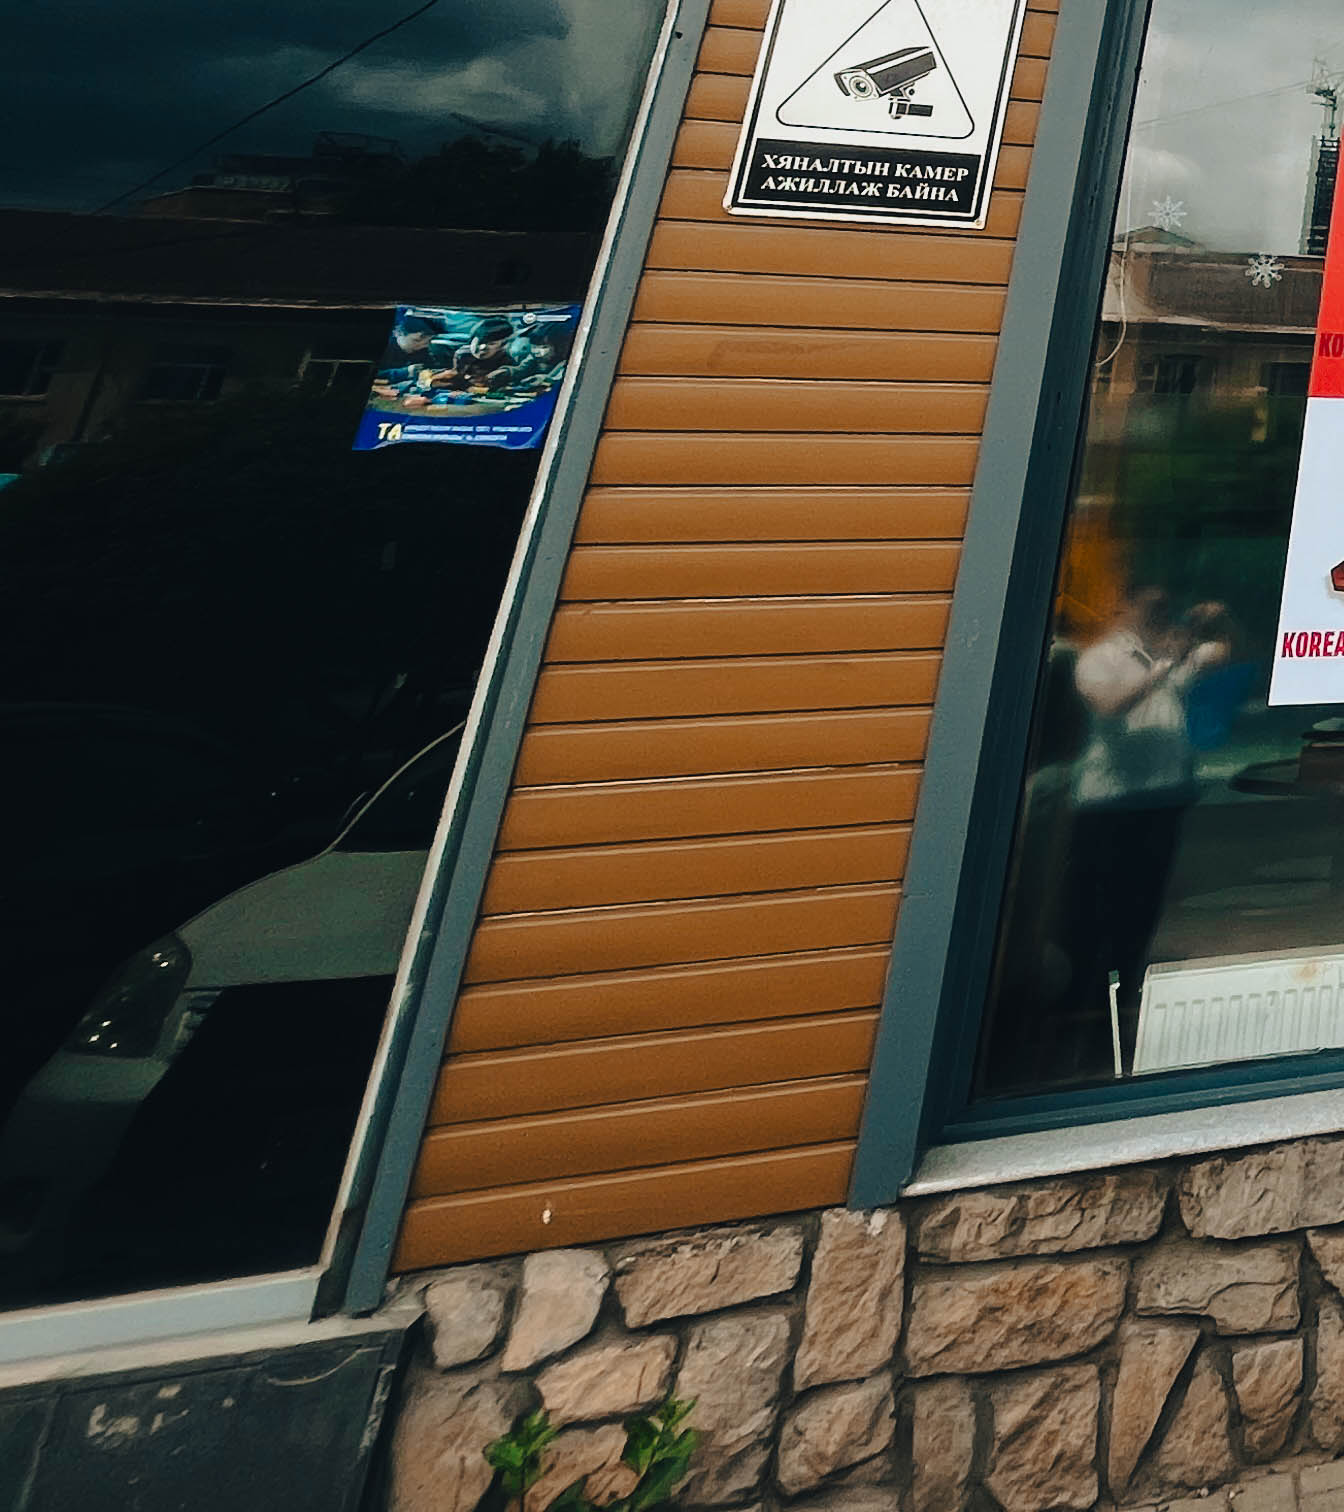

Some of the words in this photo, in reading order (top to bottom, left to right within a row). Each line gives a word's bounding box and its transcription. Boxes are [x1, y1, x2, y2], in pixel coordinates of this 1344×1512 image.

[761, 153, 890, 177] ХЯНАЛТЫН
[894, 163, 970, 183] КАМЕР
[760, 175, 883, 197] АЖИЛЛАЖ
[887, 181, 960, 202] БАЙНА
